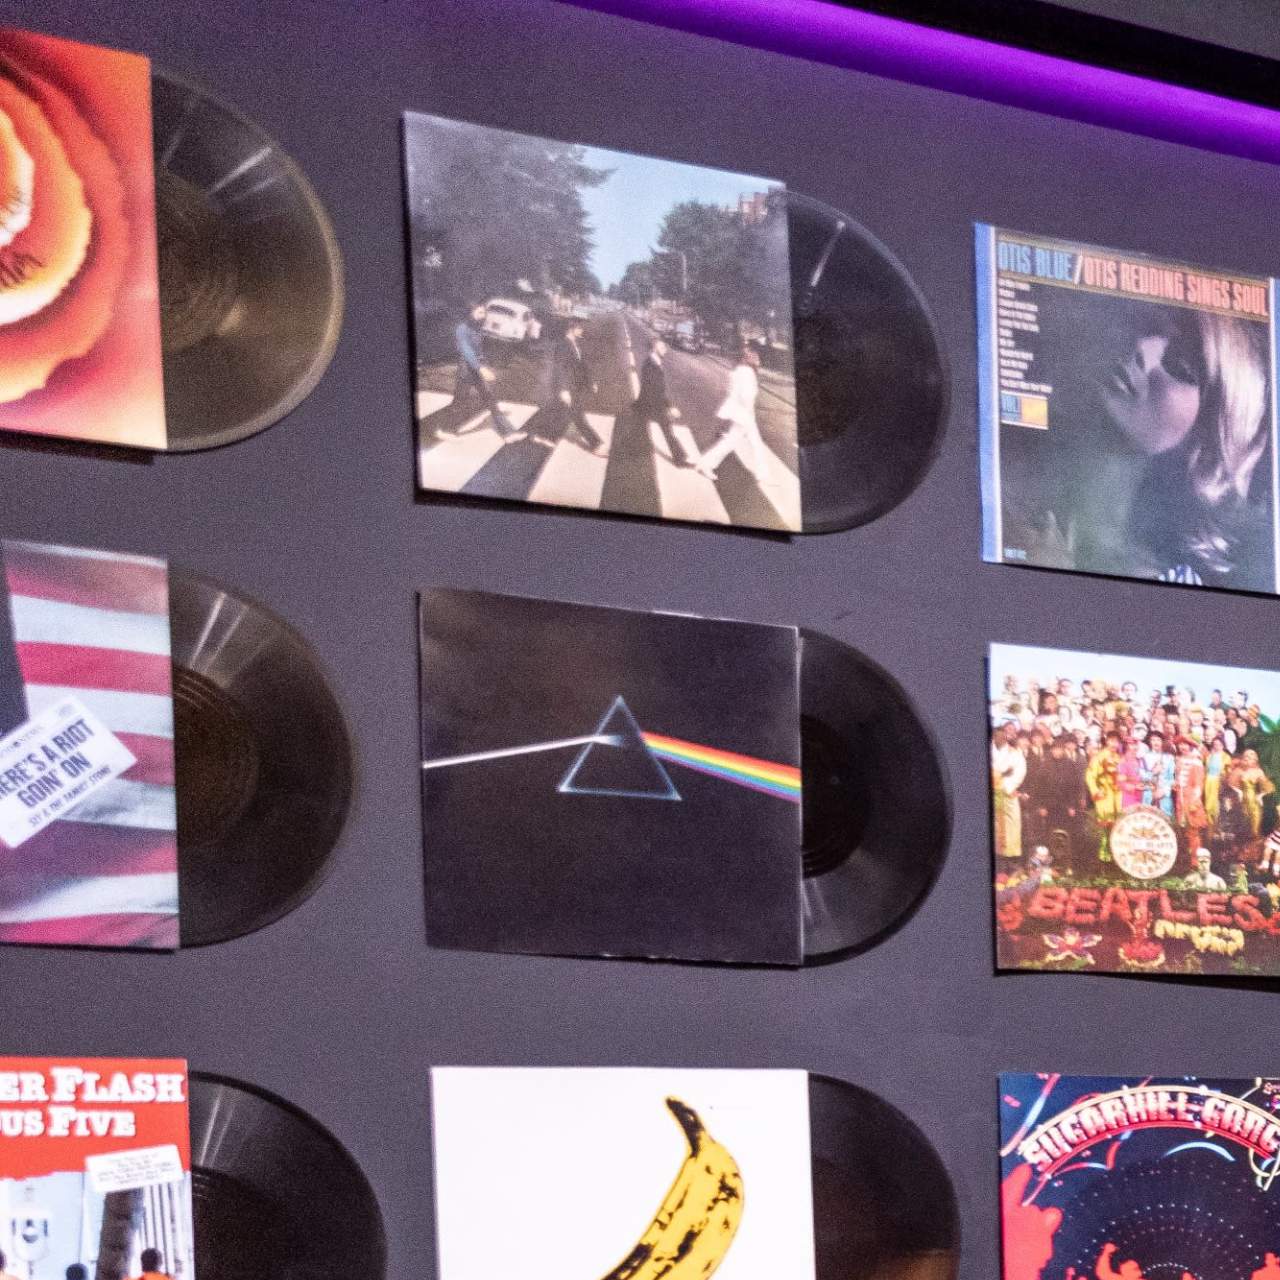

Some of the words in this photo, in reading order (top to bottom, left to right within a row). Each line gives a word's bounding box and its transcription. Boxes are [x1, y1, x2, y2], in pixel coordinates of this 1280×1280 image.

[1000, 242, 1032, 275] OTIS
[1083, 258, 1118, 289] OTIS
[1120, 263, 1184, 300] REDDING
[1187, 274, 1230, 308] SINGS
[1232, 284, 1269, 316] SOUL
[41, 744, 60, 763] A
[52, 718, 95, 754] RIOT
[60, 751, 93, 778] ON
[1029, 887, 1261, 933] BEATLES
[0, 1071, 49, 1103] ER
[51, 1066, 186, 1103] FLASH
[0, 1109, 45, 1137] US
[48, 1104, 136, 1137] FIVE
[1022, 1091, 1195, 1172] SUGARHILL
